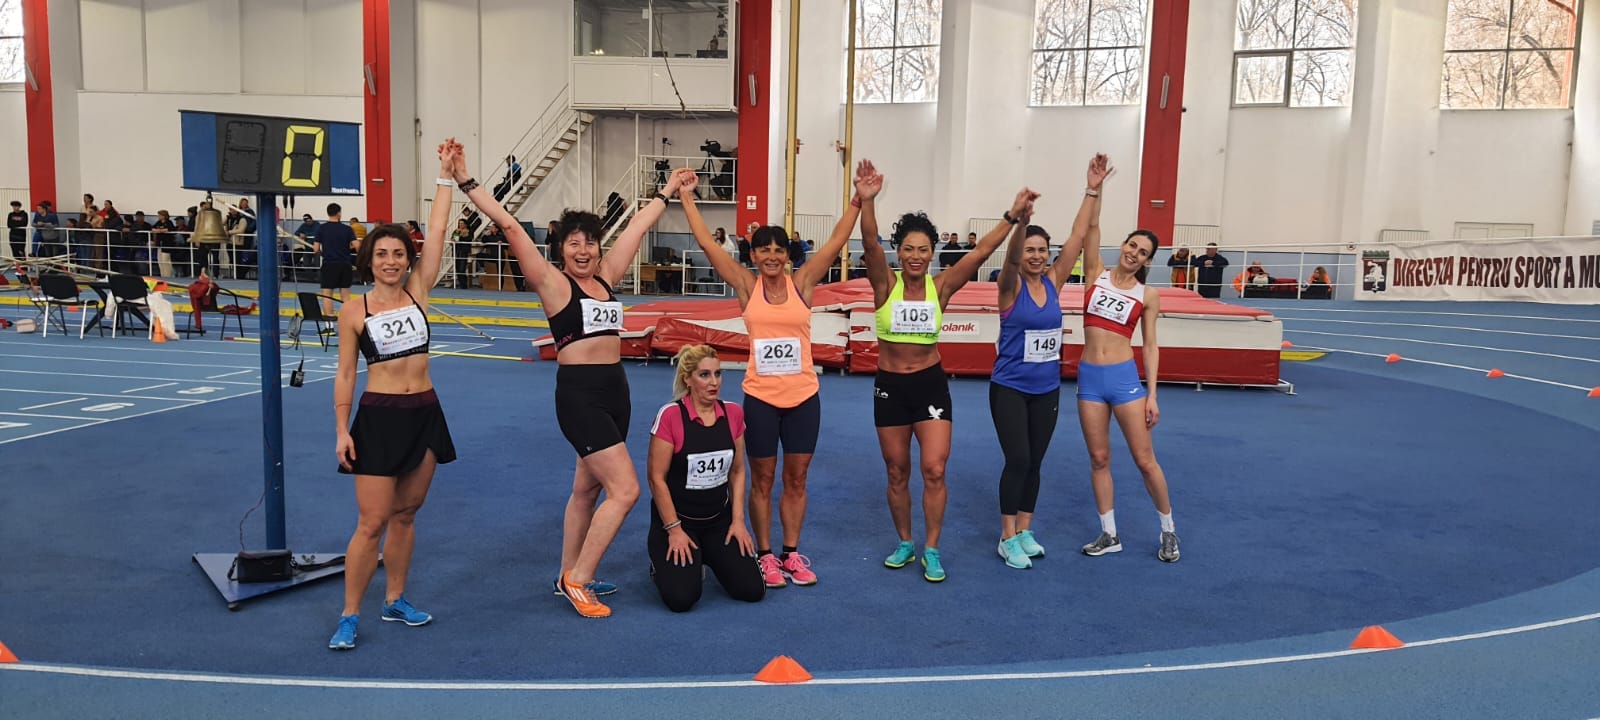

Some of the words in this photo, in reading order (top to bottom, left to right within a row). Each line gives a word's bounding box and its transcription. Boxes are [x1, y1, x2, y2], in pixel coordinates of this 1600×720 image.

[281, 124, 325, 188] 0
[1457, 256, 1513, 288] PENTRU
[1514, 255, 1562, 289] SPORT
[1563, 256, 1576, 289] A
[1096, 294, 1126, 312] 275
[592, 307, 618, 324] 218
[900, 308, 929, 322] 105
[380, 316, 416, 339] 321
[939, 322, 975, 332] olanik
[763, 343, 794, 359] 262
[1033, 337, 1056, 351] 149
[696, 456, 724, 474] 341
